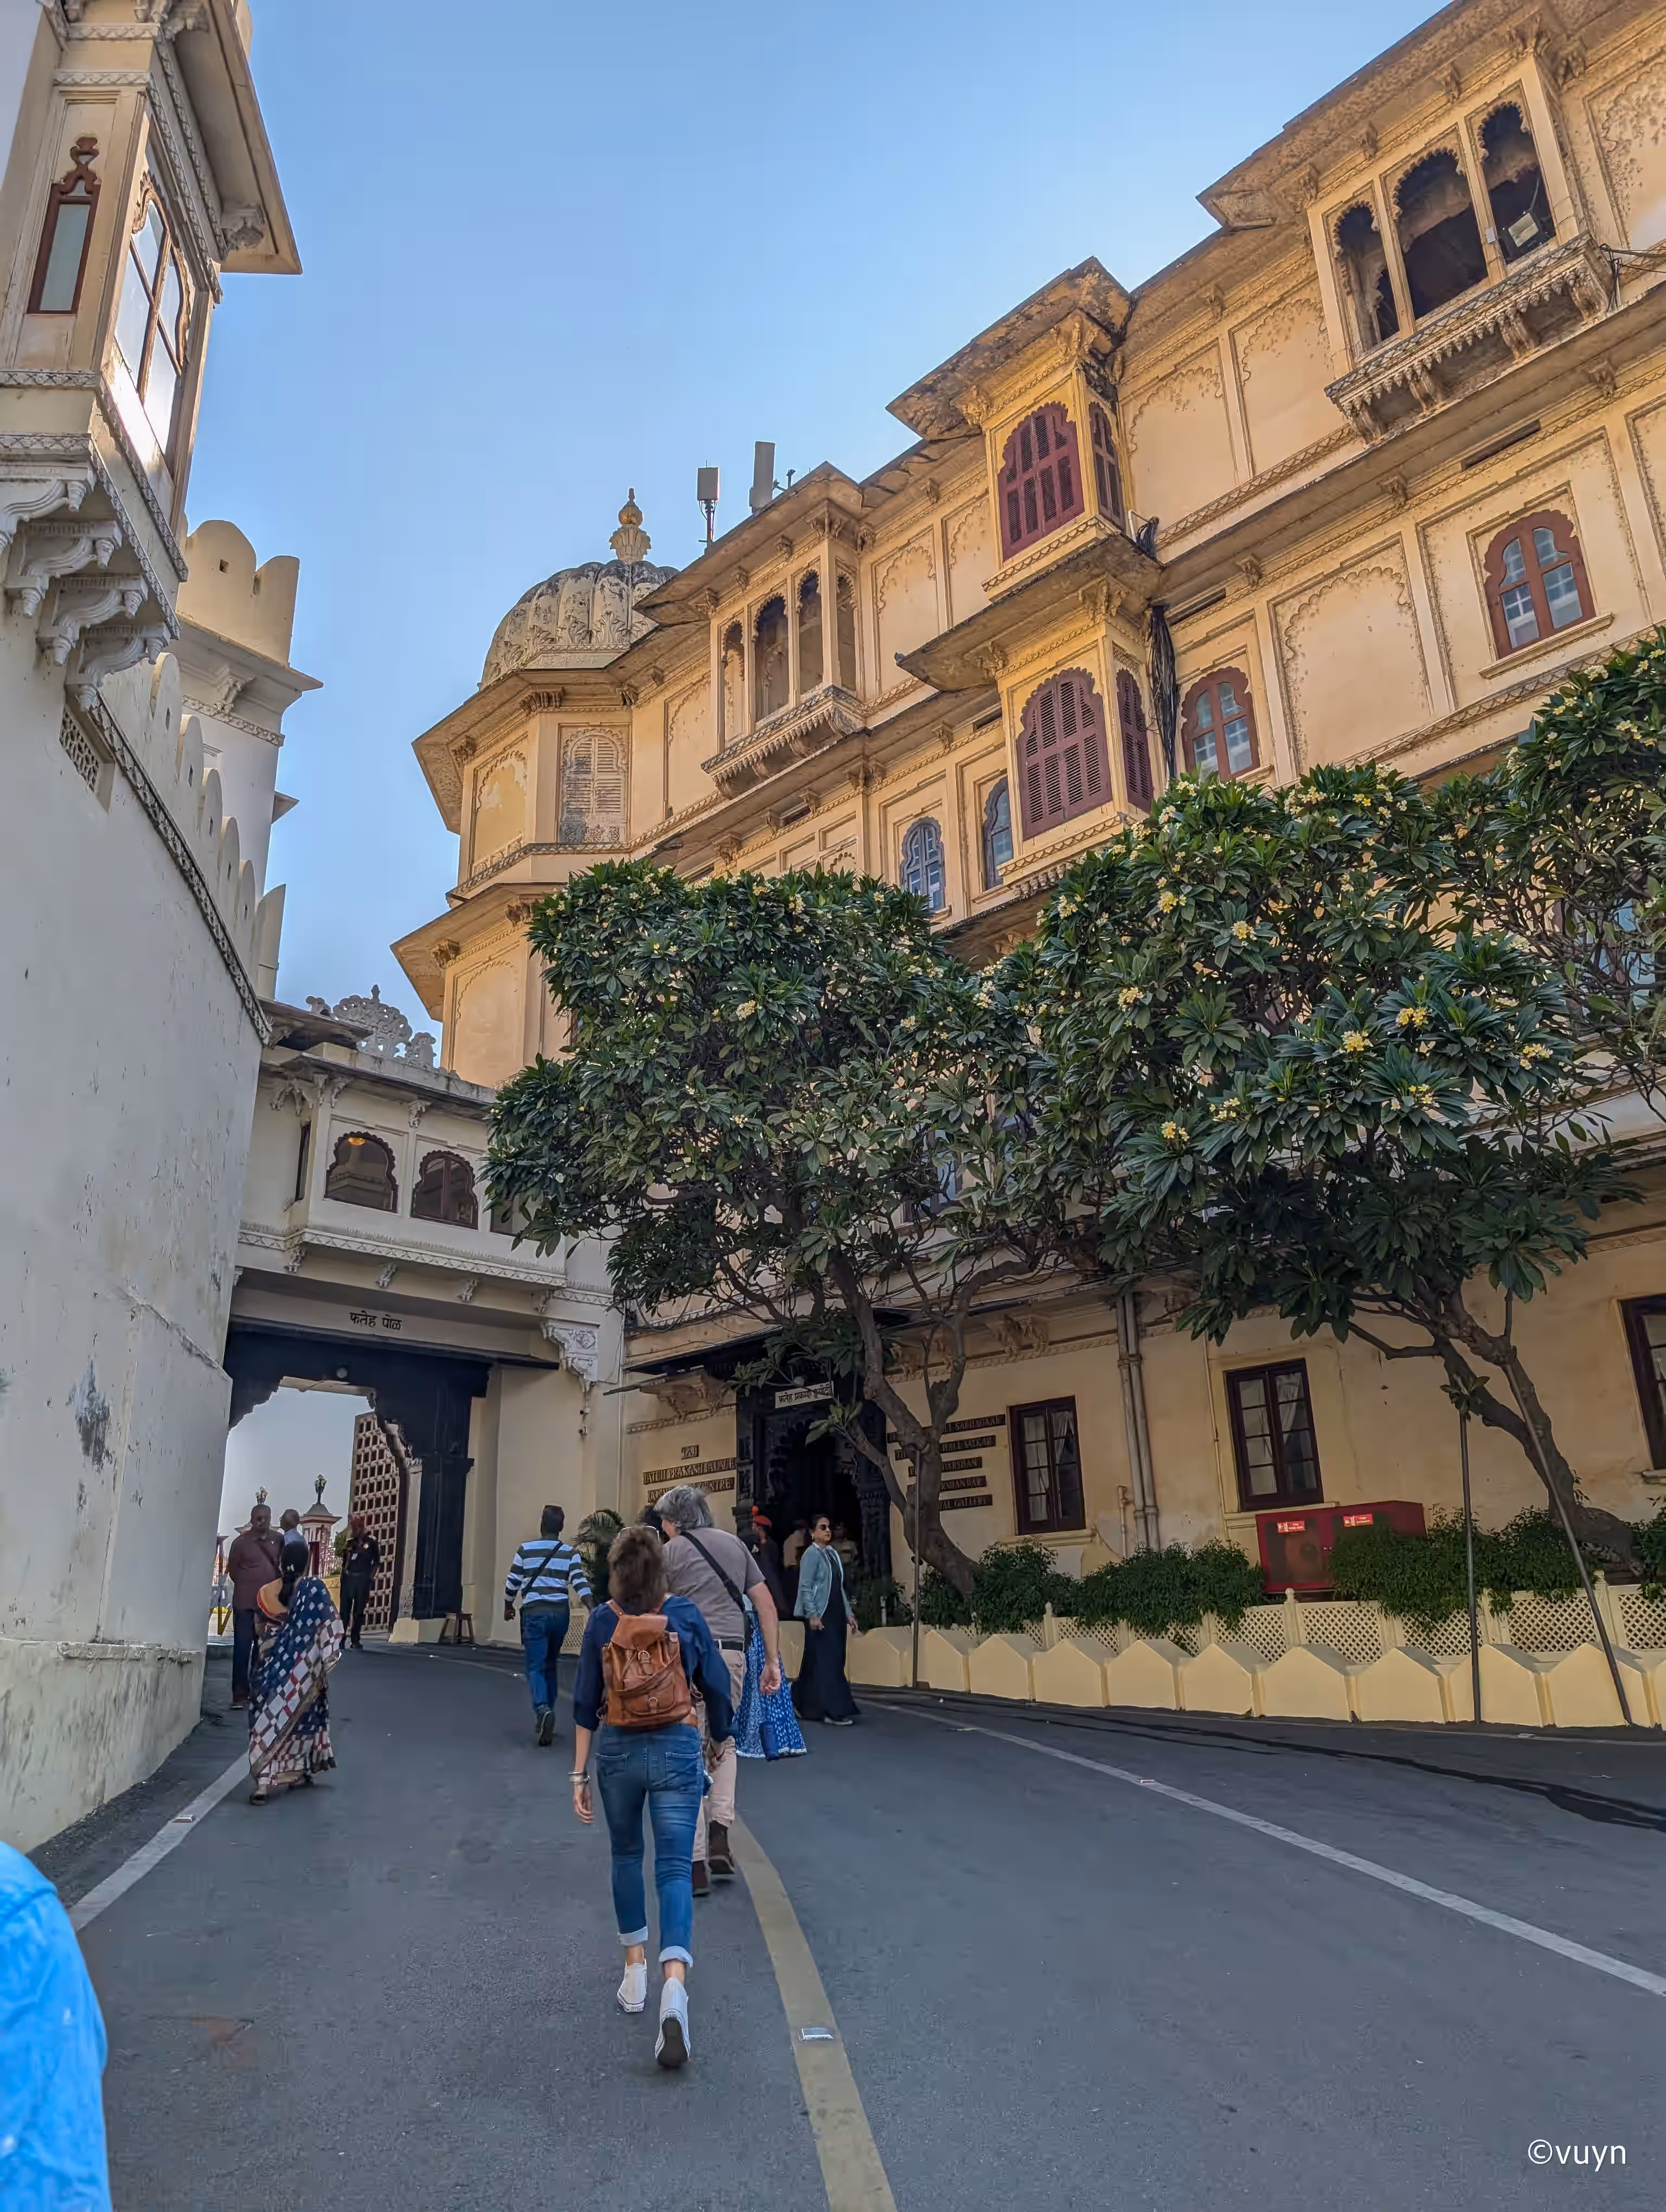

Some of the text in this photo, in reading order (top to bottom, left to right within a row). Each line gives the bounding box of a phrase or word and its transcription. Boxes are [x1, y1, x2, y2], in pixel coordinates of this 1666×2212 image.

[350, 1310, 377, 1328] फतेह
[682, 1445, 697, 1458] TAJ
[668, 1464, 703, 1479] PRAKASH
[705, 1458, 735, 1473] PALACE
